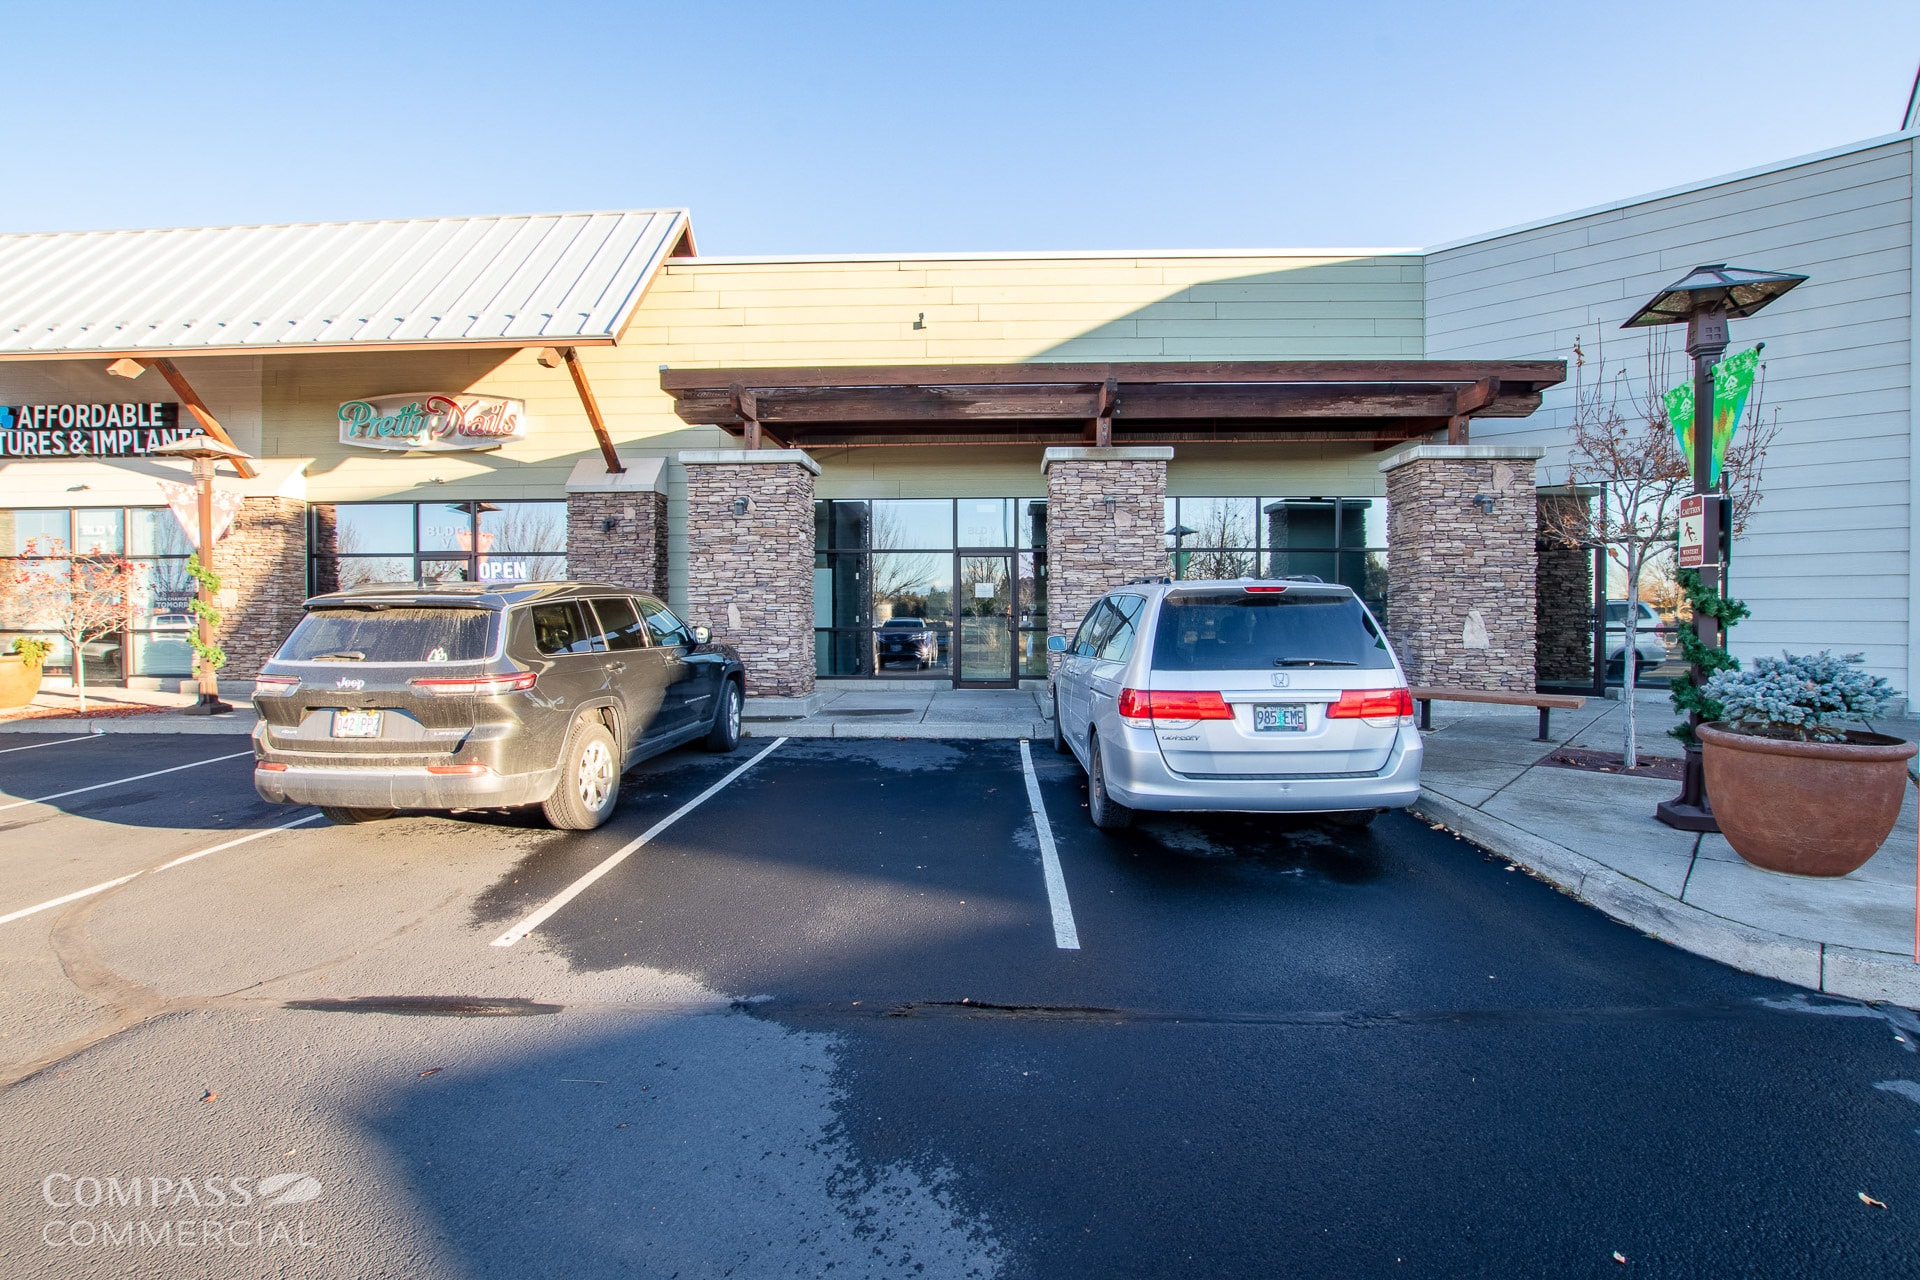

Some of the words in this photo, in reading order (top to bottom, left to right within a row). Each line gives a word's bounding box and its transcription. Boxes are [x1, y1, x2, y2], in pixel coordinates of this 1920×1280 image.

[17, 402, 163, 429] AFFORDABLE
[338, 401, 430, 446] Pretty
[426, 396, 517, 436] Nails
[69, 430, 88, 453] &
[480, 561, 527, 579] OPEN
[336, 677, 365, 690] Jeep
[1257, 710, 1277, 725] 985
[1283, 710, 1304, 725] EME
